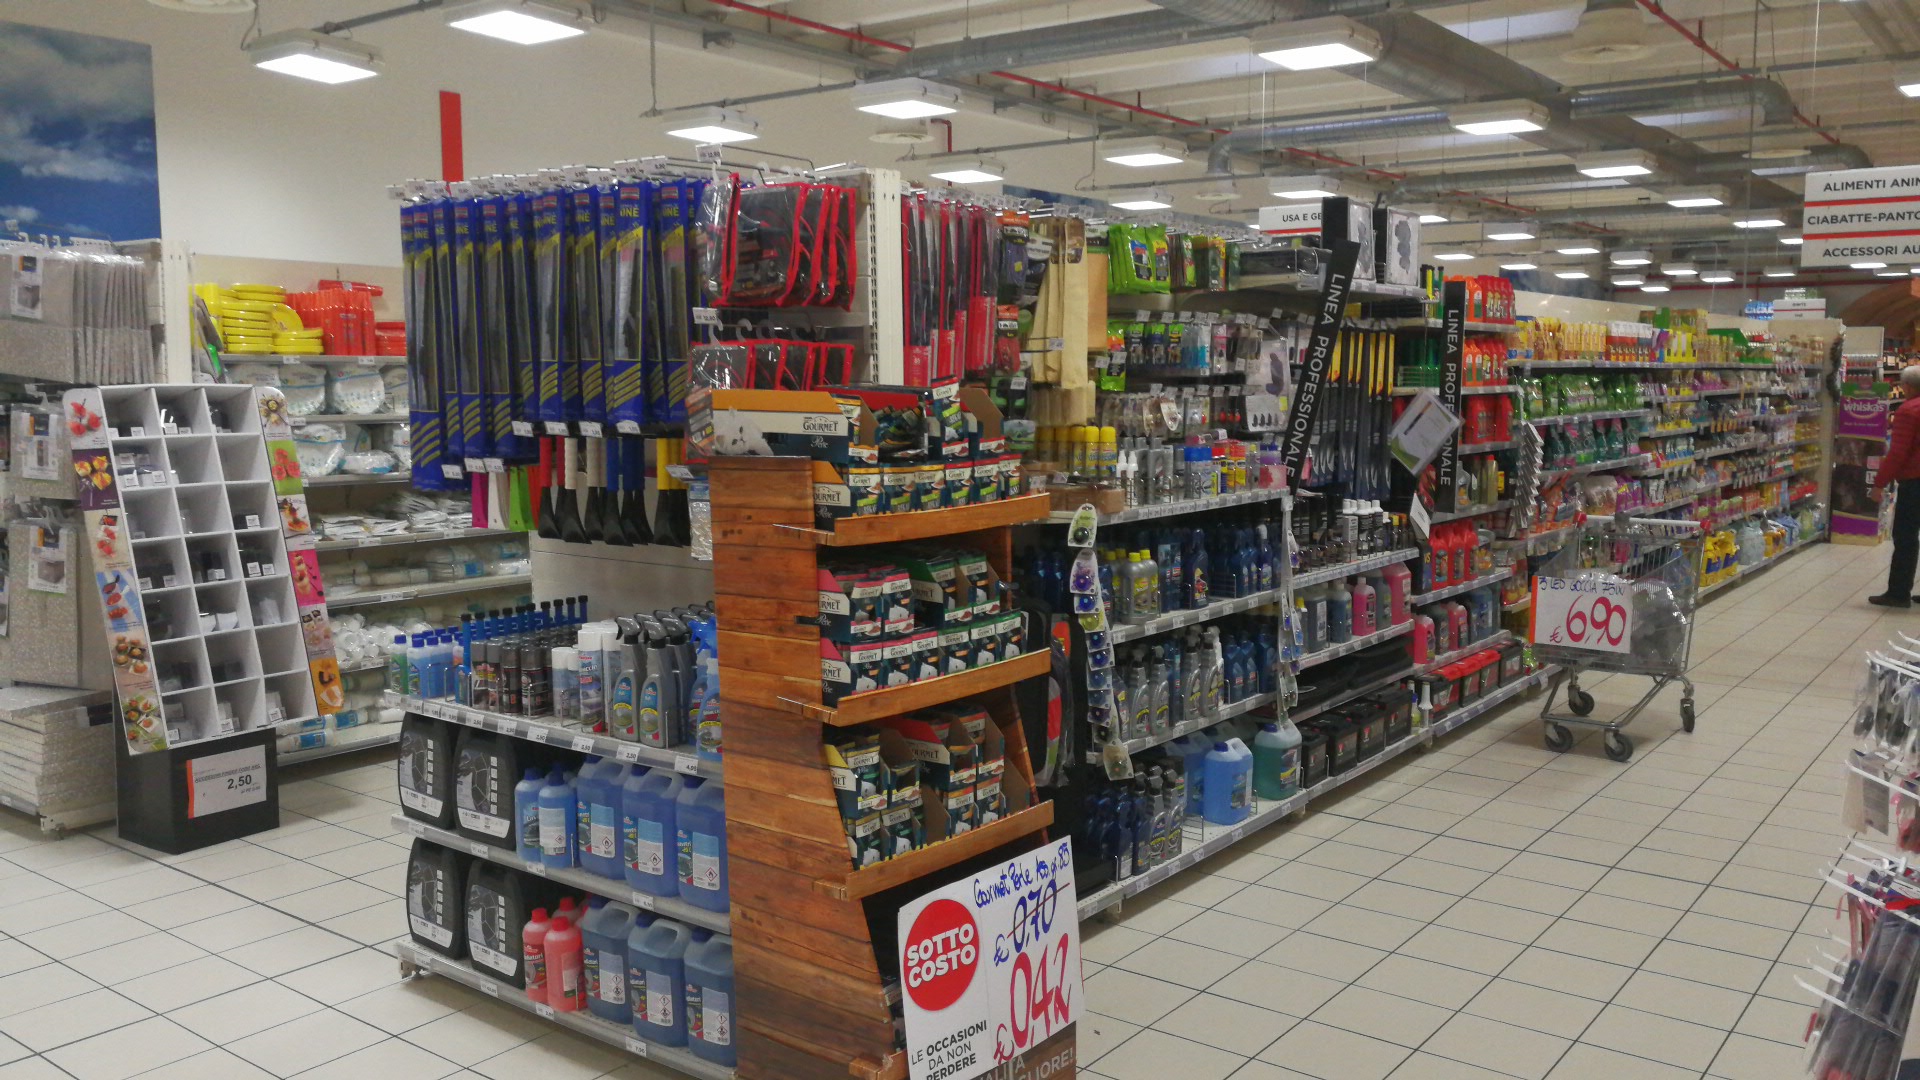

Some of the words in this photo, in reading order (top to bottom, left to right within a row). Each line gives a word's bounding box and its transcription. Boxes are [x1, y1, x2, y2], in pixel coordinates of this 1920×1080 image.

[1823, 179, 1886, 192] ALIMENTI
[1282, 213, 1301, 223] USA
[1302, 212, 1309, 221] E
[1822, 245, 1898, 258] ACCESSORI
[1320, 273, 1346, 326] LINEA
[1446, 310, 1459, 354] LINEA
[1285, 336, 1330, 478] PROFESSIONALE
[1843, 400, 1885, 412] whiskas
[802, 420, 839, 432] GOURMET
[1441, 362, 1457, 486] PROFEONALE
[814, 490, 841, 502] OURMET
[1550, 579, 1566, 590] LED
[1570, 580, 1598, 594] GOCCIA
[821, 600, 841, 611] RMET
[1549, 626, 1563, 644] €
[1566, 594, 1627, 647] 6,90
[823, 668, 842, 678] RMET
[227, 774, 252, 790] 2,50
[1013, 879, 1058, 954] 0,70
[907, 923, 975, 967] SOTTO
[908, 944, 976, 988] COSTO
[1010, 932, 1072, 1049] 0,42
[911, 1049, 924, 1066] LE
[926, 1020, 988, 1057] OCCASIONI
[928, 1057, 945, 1071] DA
[947, 1041, 972, 1062] NON
[926, 1053, 977, 1080] PERDERE
